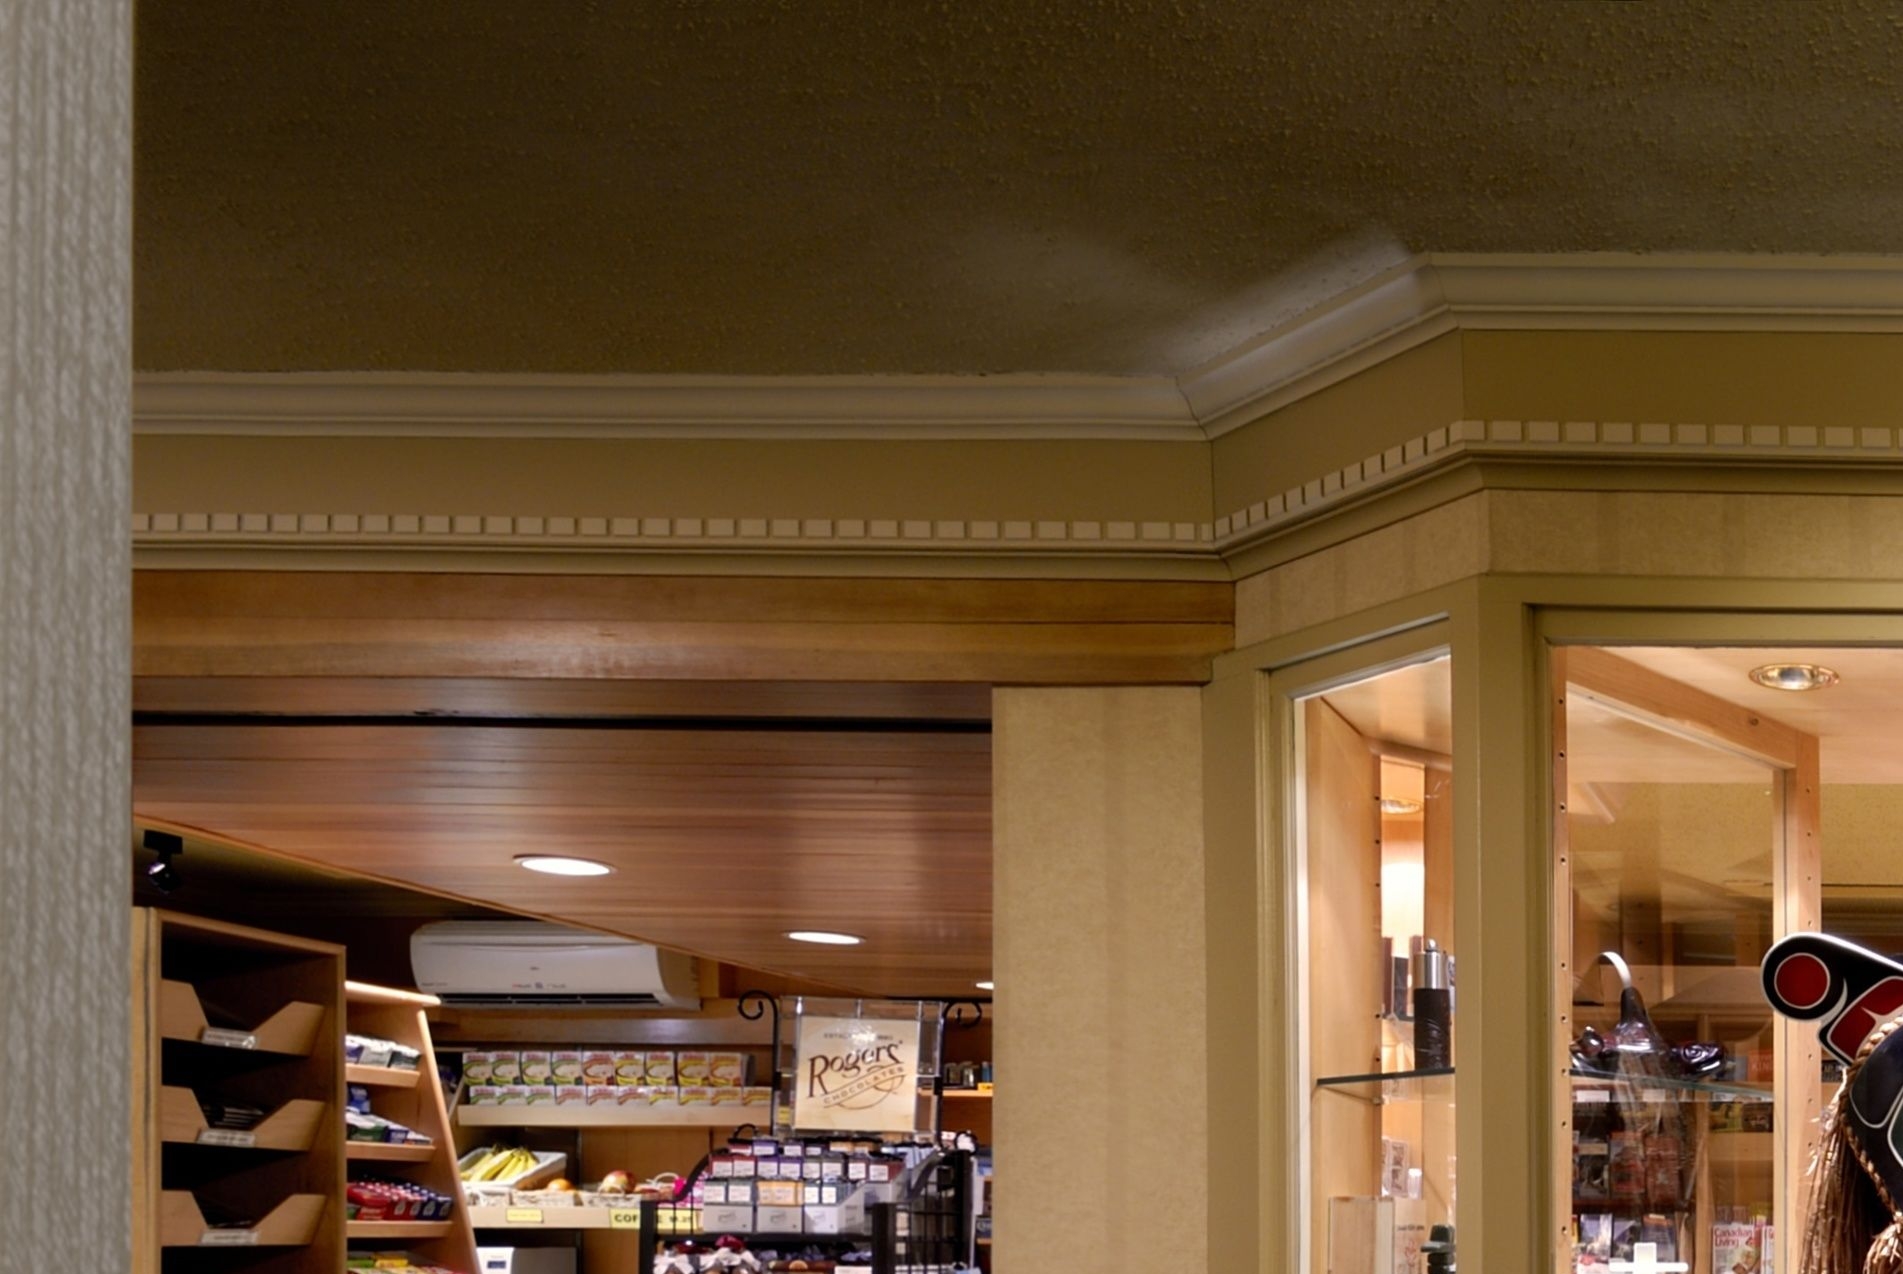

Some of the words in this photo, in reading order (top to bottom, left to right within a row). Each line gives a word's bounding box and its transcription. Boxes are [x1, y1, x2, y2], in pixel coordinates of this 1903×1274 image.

[823, 1066, 904, 1104] CHOCOLATES
[1714, 1227, 1753, 1238] Canadian
[1715, 1236, 1739, 1248] Living
